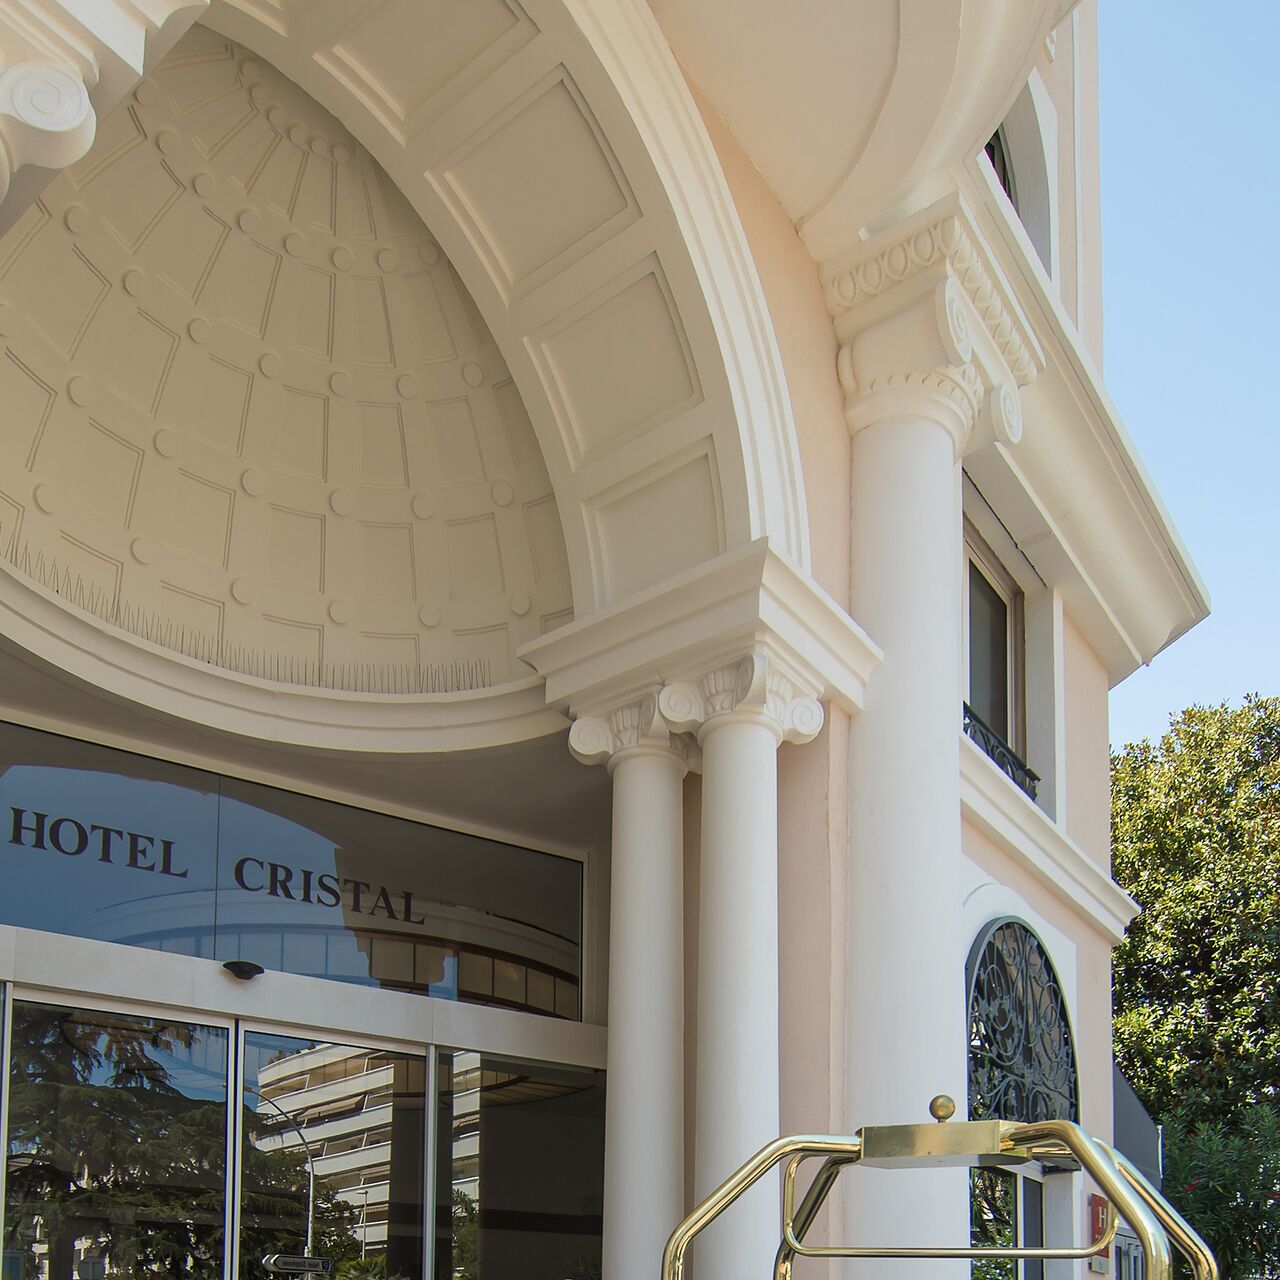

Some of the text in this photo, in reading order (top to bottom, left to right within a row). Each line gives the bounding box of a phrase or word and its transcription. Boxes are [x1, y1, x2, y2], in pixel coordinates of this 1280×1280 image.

[8, 806, 425, 926] HOTEL CRISTAL
[1098, 1206, 1107, 1229] H
